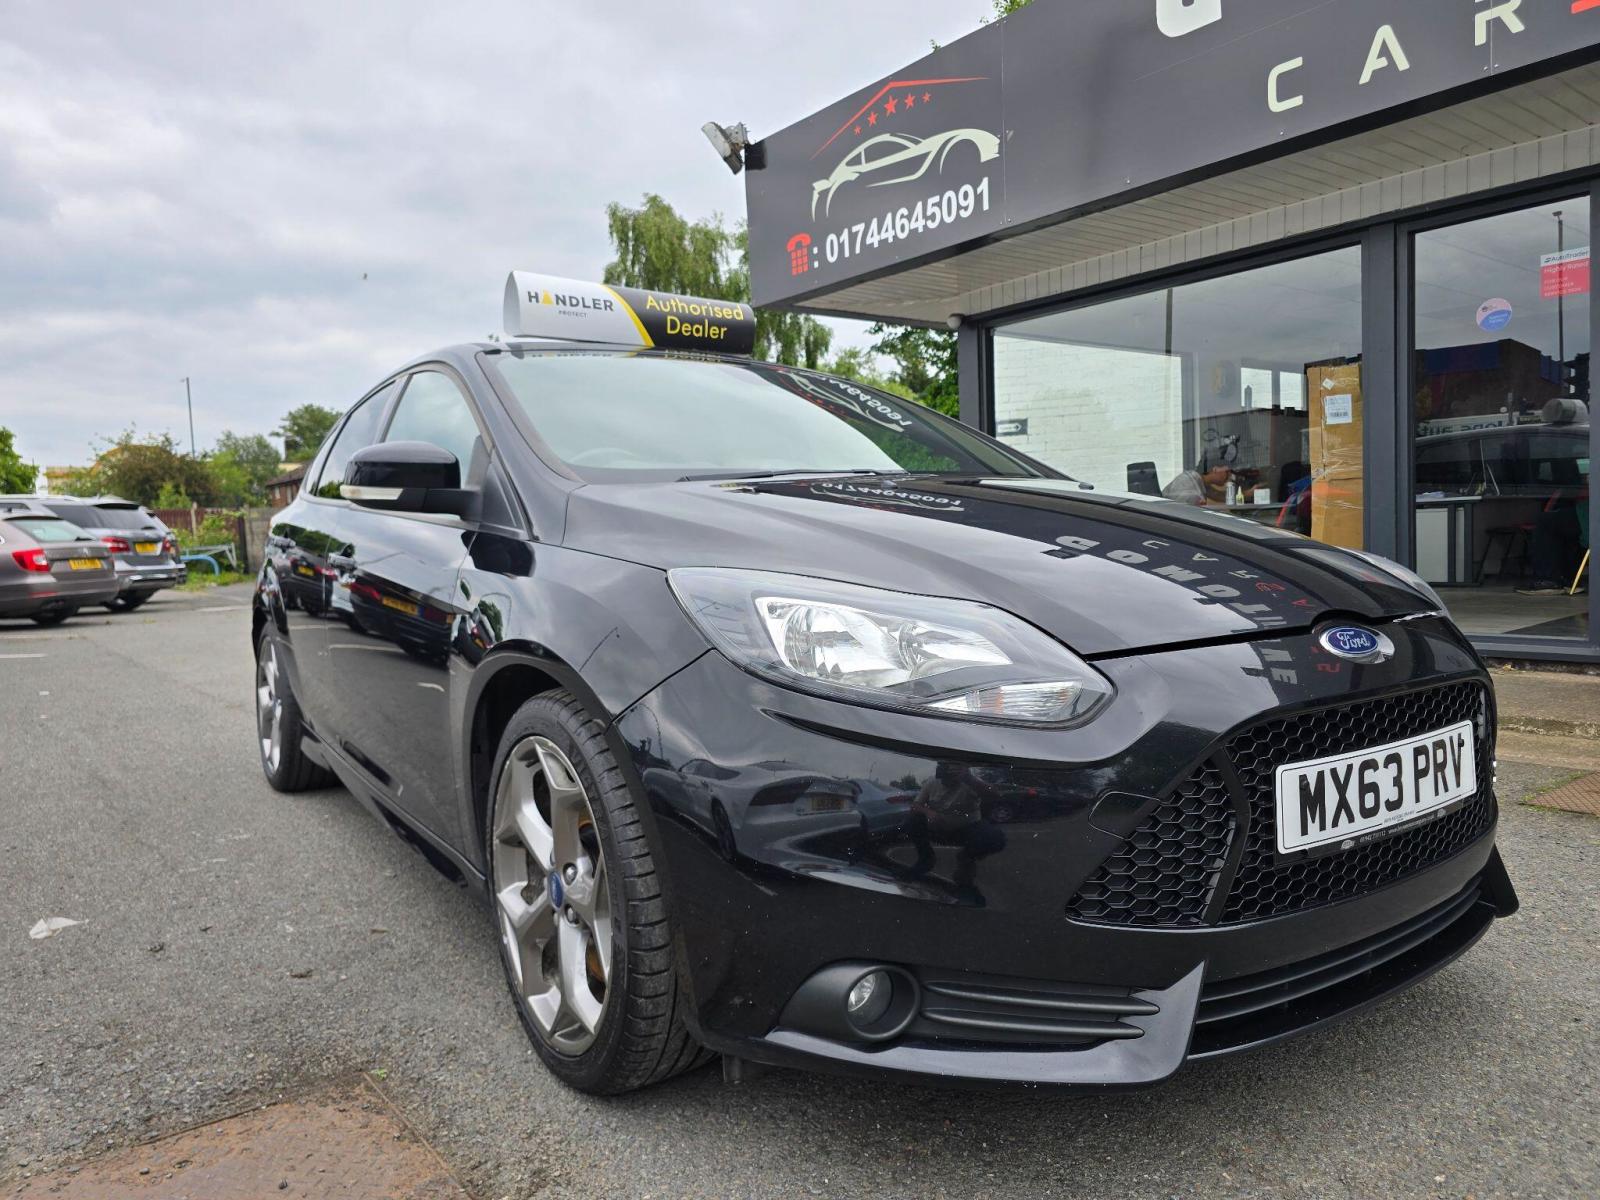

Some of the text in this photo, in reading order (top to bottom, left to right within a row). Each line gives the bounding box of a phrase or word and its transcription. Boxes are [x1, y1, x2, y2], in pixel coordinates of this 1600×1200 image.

[825, 177, 990, 263] 01744645091
[558, 310, 588, 318] PROTECT
[646, 295, 744, 321] Authorised
[666, 315, 728, 340] Dealer
[1336, 630, 1371, 649] Ford
[1298, 732, 1464, 837] MX63 PRV
